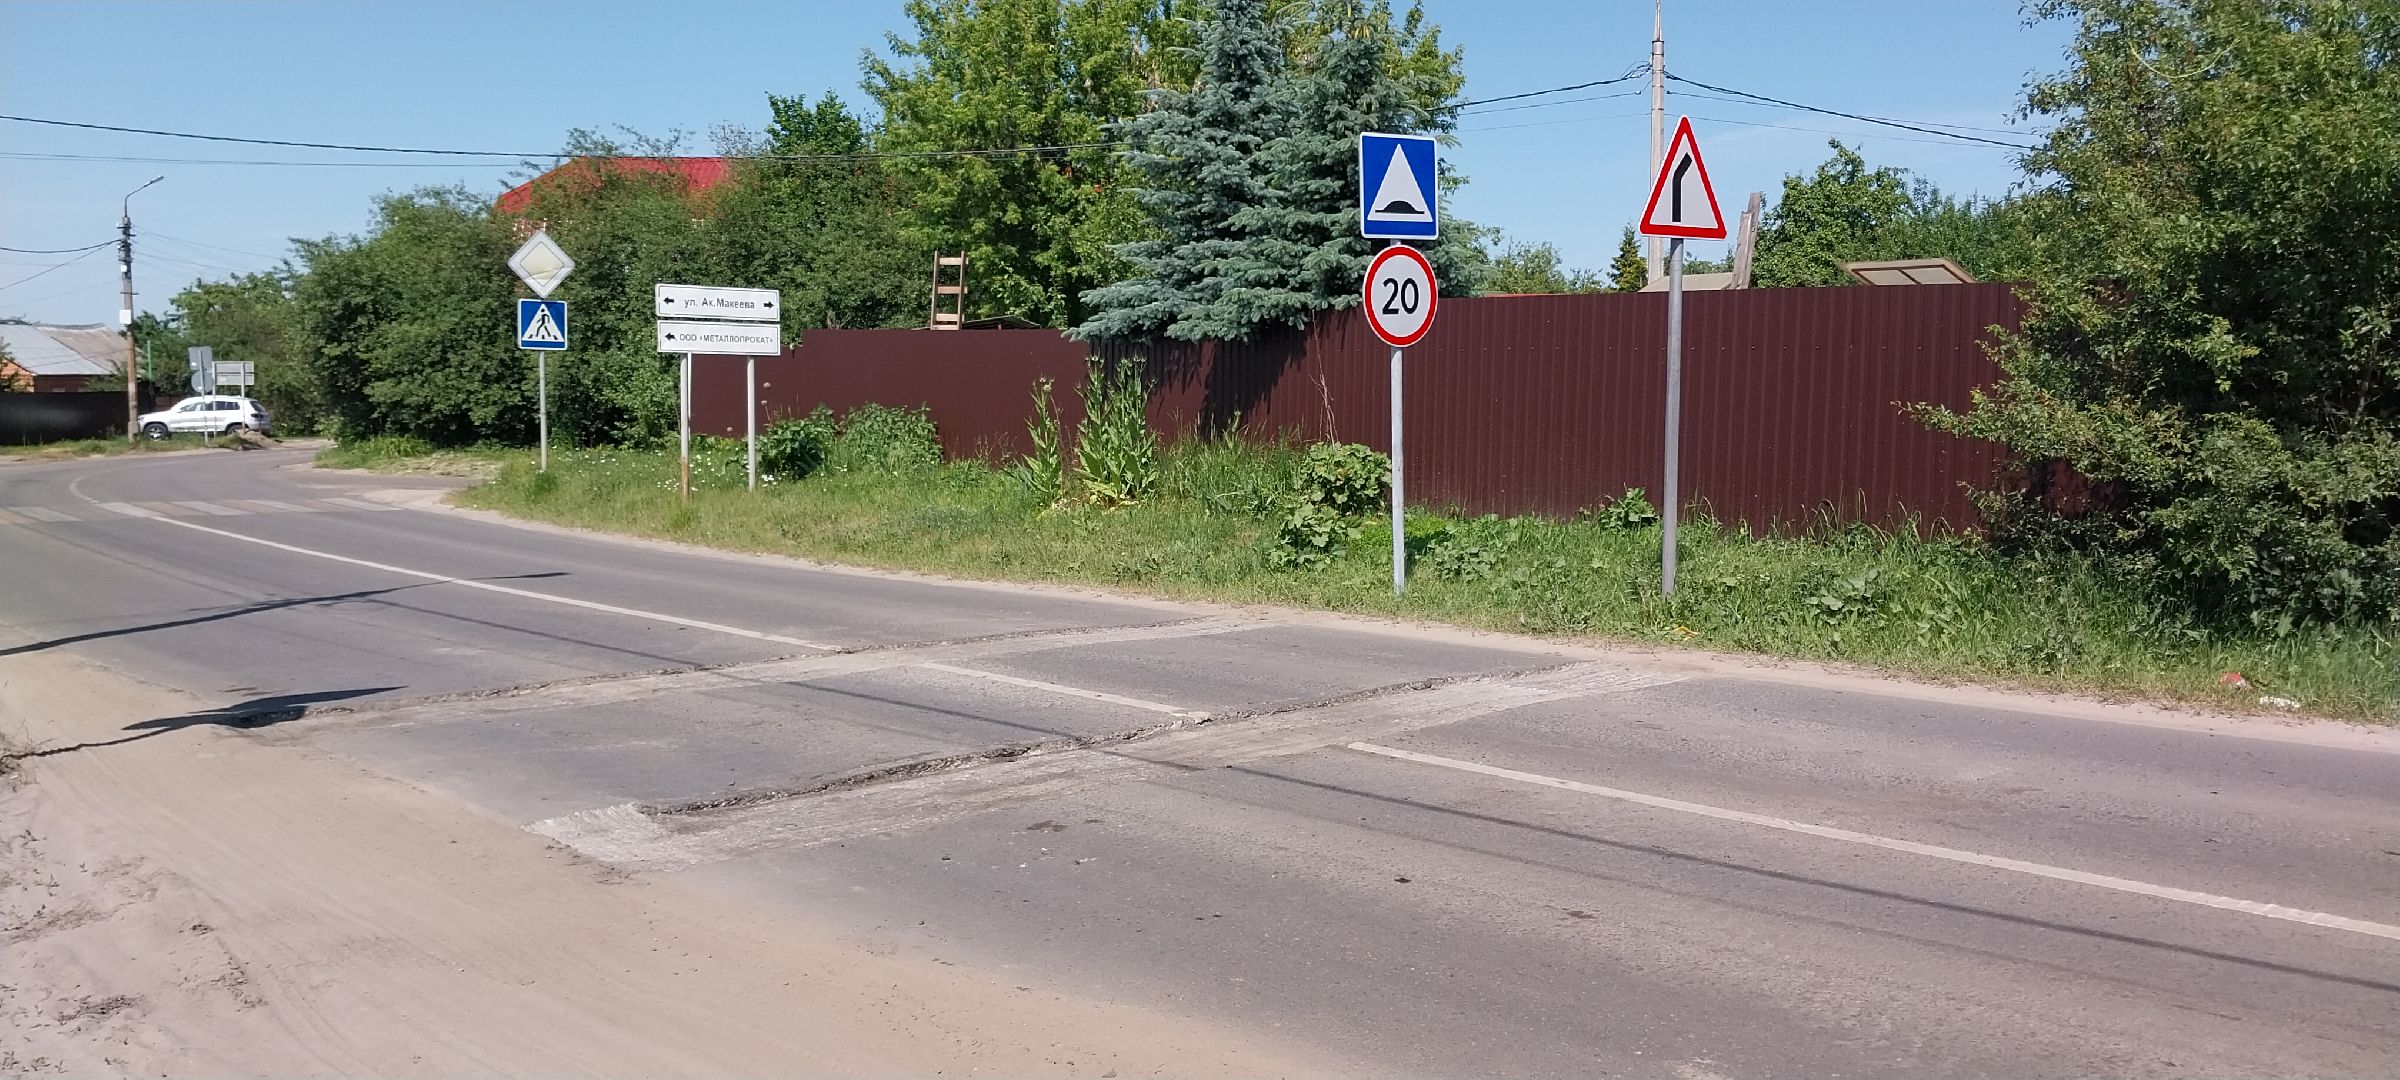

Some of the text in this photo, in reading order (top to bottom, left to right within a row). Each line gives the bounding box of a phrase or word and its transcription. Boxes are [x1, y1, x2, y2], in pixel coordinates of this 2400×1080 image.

[1382, 277, 1419, 315] 20
[684, 298, 698, 308] ул.
[679, 333, 697, 342] ООО
